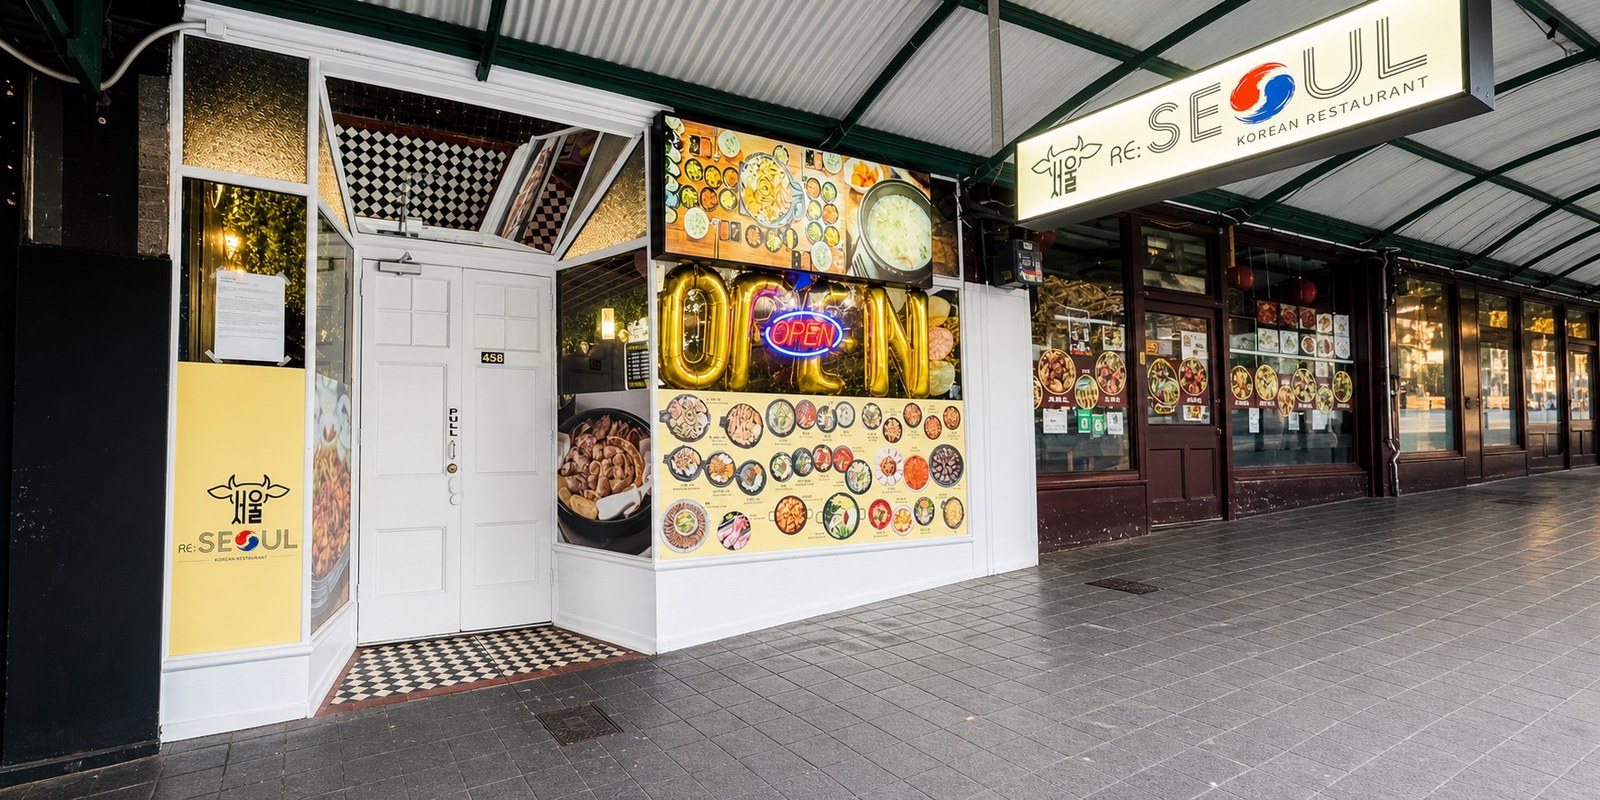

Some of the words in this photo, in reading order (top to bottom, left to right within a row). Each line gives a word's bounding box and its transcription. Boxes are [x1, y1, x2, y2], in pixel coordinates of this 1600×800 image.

[1110, 139, 1142, 167] RE:
[1147, 16, 1428, 154] SEOUL
[1236, 118, 1299, 147] KOREAN
[1305, 75, 1429, 125] RESTAURANT
[772, 320, 836, 348] OPEN
[482, 353, 504, 363] 458
[449, 408, 458, 437] PULL
[178, 543, 197, 554] RE:
[198, 529, 298, 554] SEOUL
